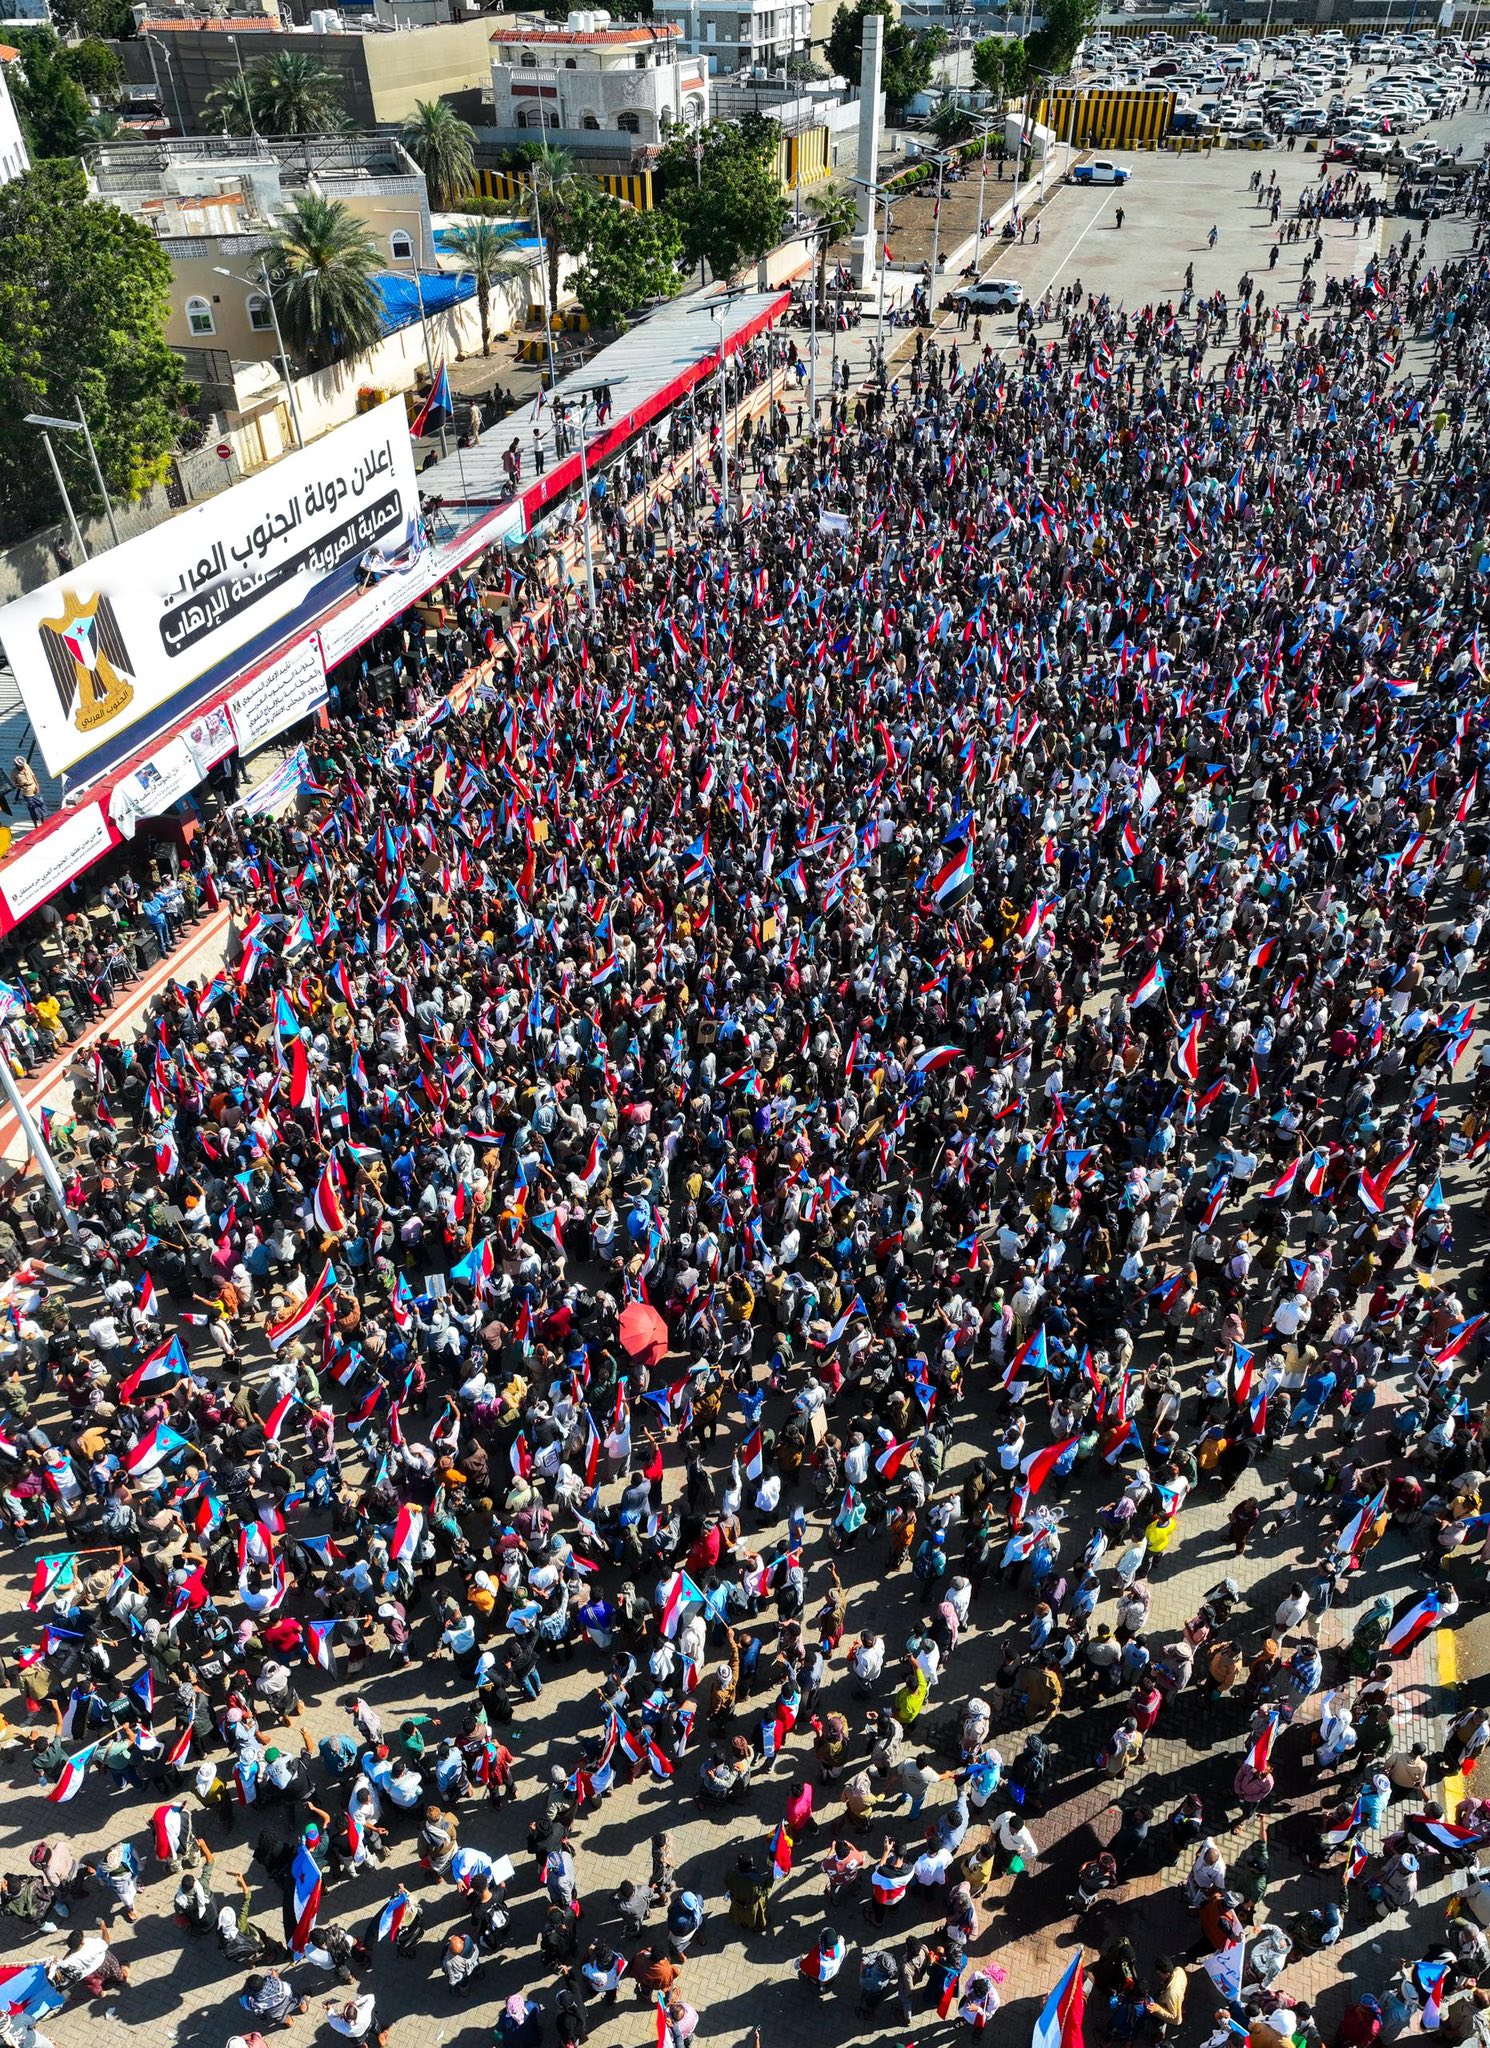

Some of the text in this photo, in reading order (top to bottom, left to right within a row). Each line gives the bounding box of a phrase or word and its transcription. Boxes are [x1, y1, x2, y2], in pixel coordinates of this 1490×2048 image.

[352, 440, 395, 496] إعلان
[305, 477, 348, 516] دولة
[358, 494, 401, 541] لحماية
[231, 496, 302, 569] الجنوب
[309, 524, 357, 573] العروبة
[165, 585, 230, 649] الإرهاب
[81, 690, 129, 729] الجنوب العربي
